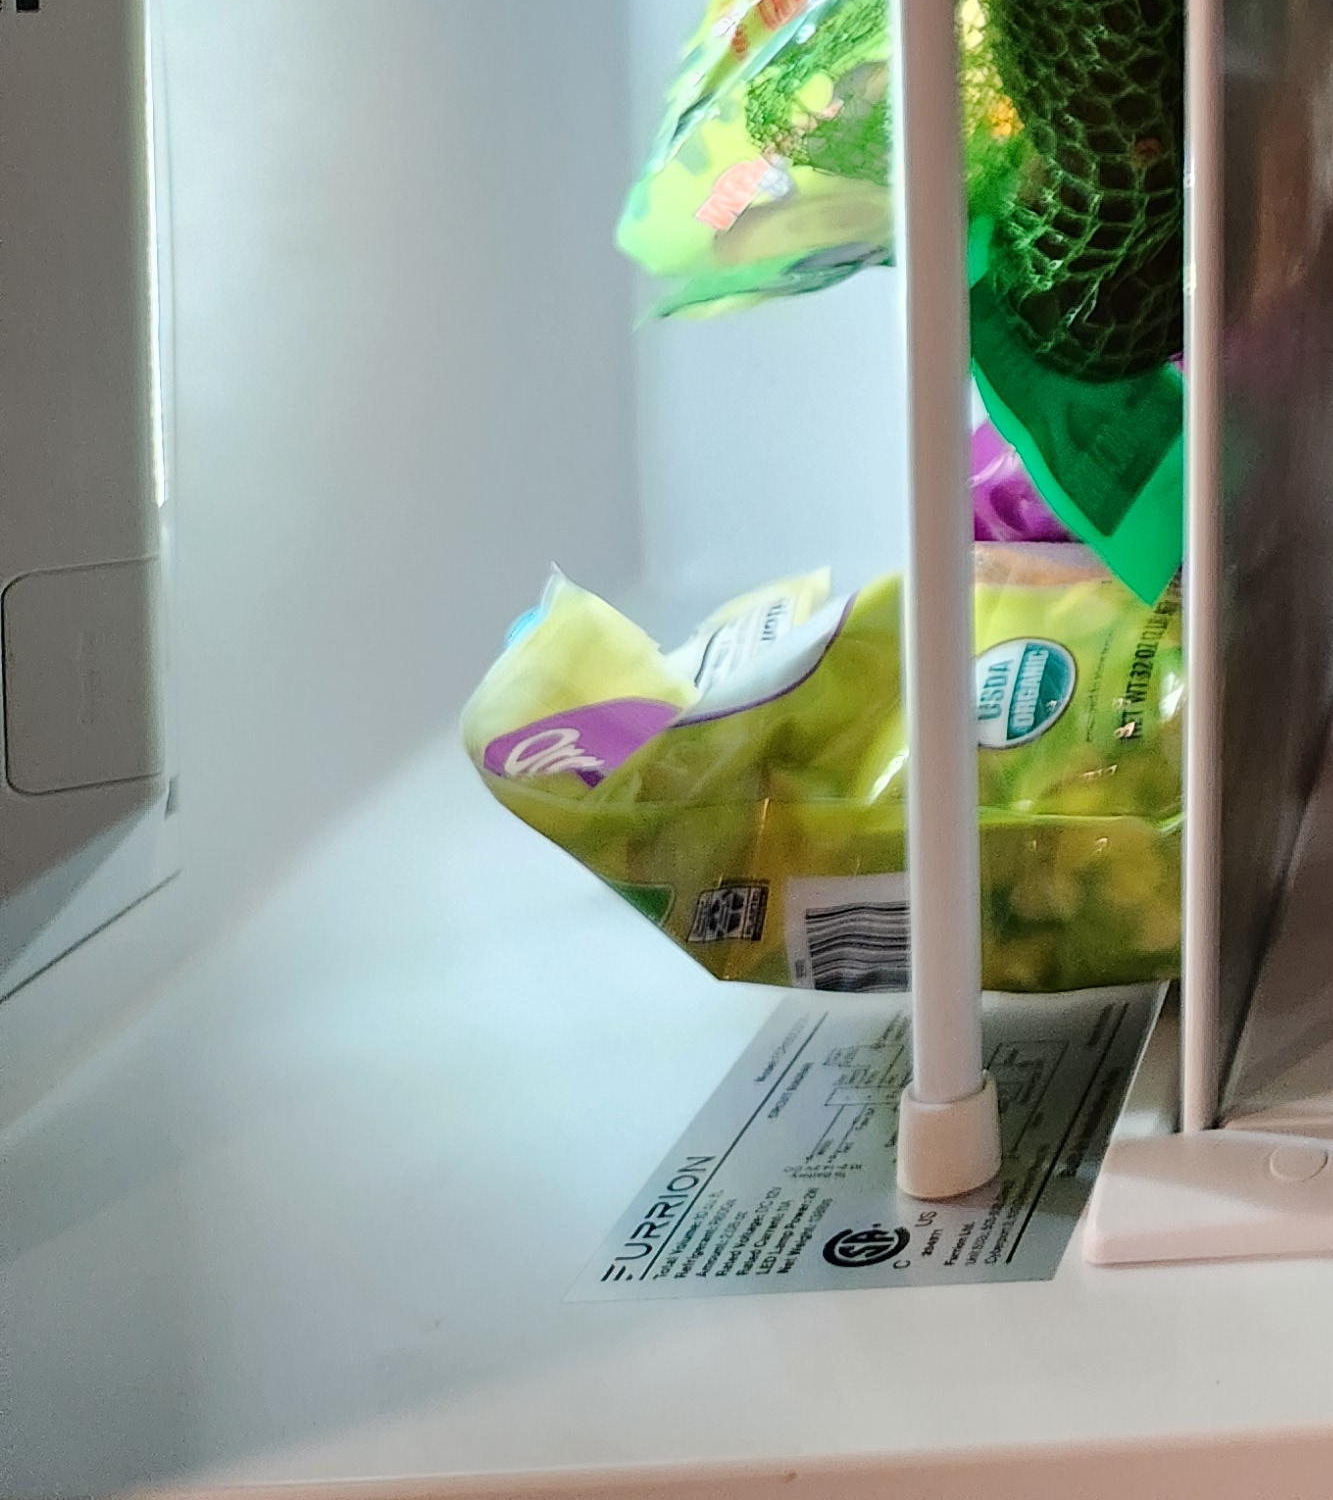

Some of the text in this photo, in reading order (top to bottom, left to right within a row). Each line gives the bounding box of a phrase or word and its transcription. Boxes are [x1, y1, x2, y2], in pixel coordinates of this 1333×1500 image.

[1134, 642, 1159, 660] OZ
[1129, 661, 1153, 680] 32
[978, 659, 1015, 721] USDA
[1013, 650, 1049, 727] ORGANIC
[601, 1155, 716, 1281] FURRION
[783, 1200, 813, 1228] Power:
[766, 1230, 796, 1253] Lamp
[893, 1211, 937, 1269] C US
[944, 1237, 967, 1266] Furrion
[650, 1256, 679, 1279] Total
[712, 1250, 743, 1276] Rated
[733, 1249, 764, 1275] Rated
[753, 1256, 780, 1274] LED
[775, 1258, 798, 1273] Net
